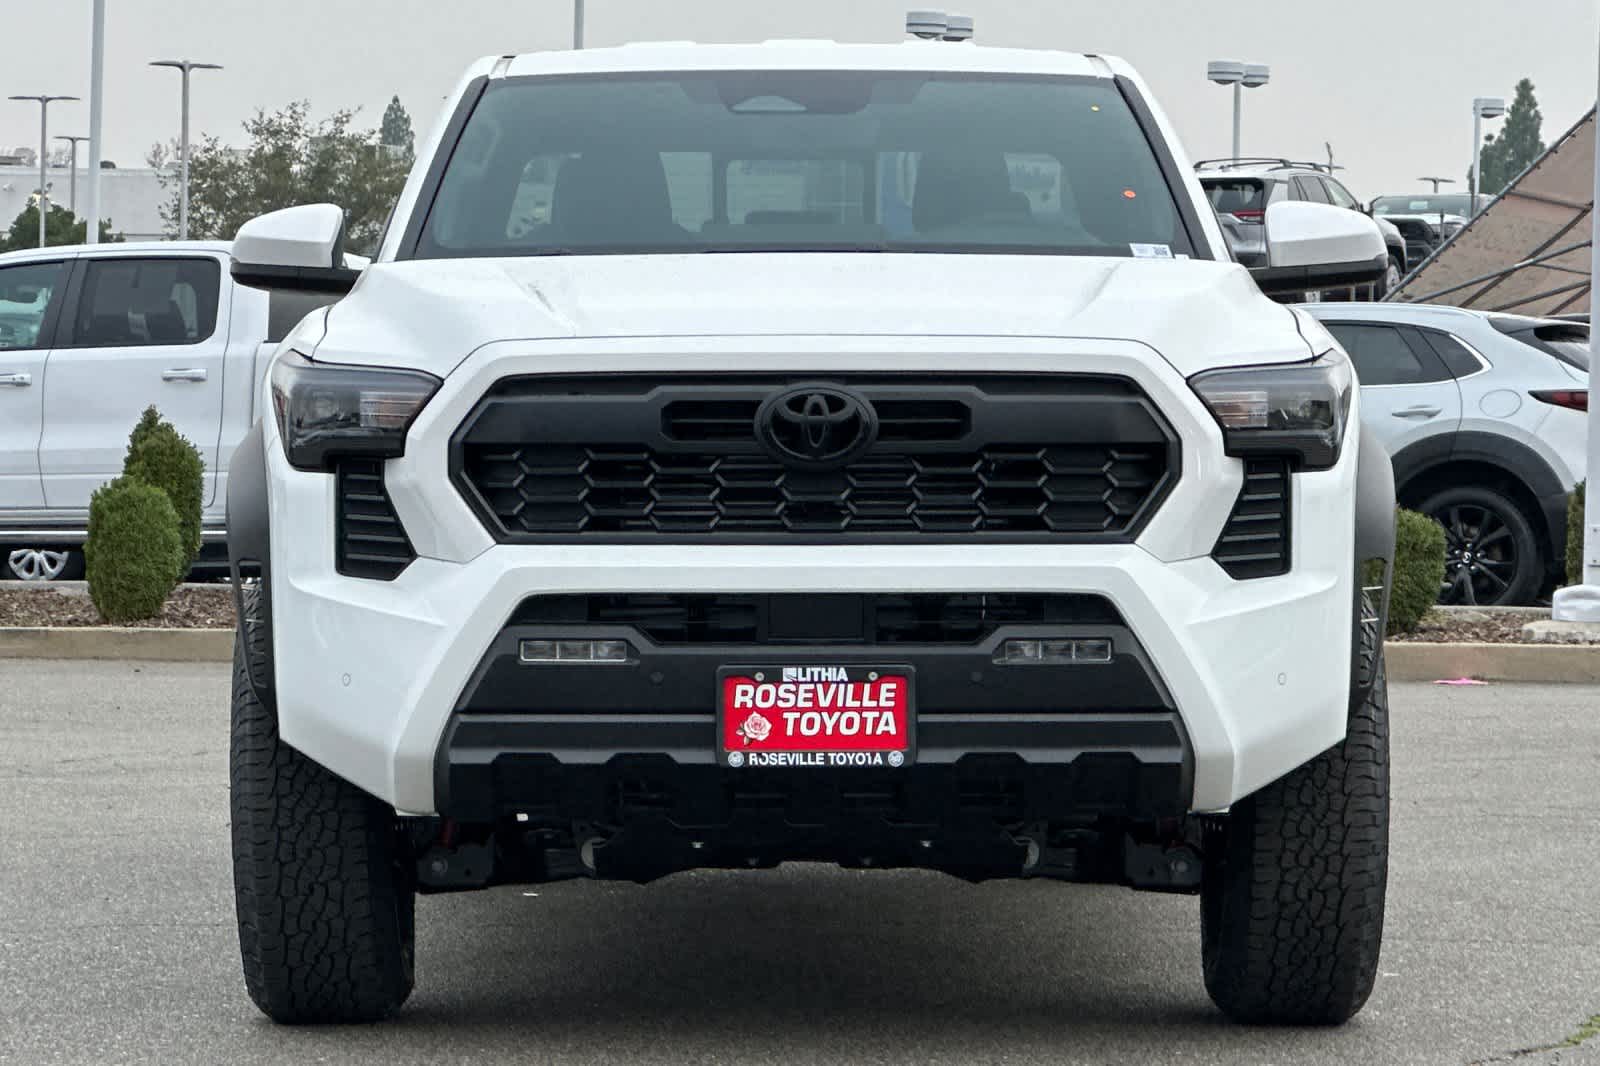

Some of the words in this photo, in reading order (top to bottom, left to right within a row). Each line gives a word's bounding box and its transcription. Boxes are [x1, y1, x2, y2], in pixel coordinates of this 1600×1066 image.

[797, 668, 848, 682] LITHIA
[734, 683, 897, 708] ROSEVILLE
[783, 711, 897, 736] TOYOTA
[749, 752, 825, 765] ROSEVILLE
[829, 752, 883, 765] TOYOTA
